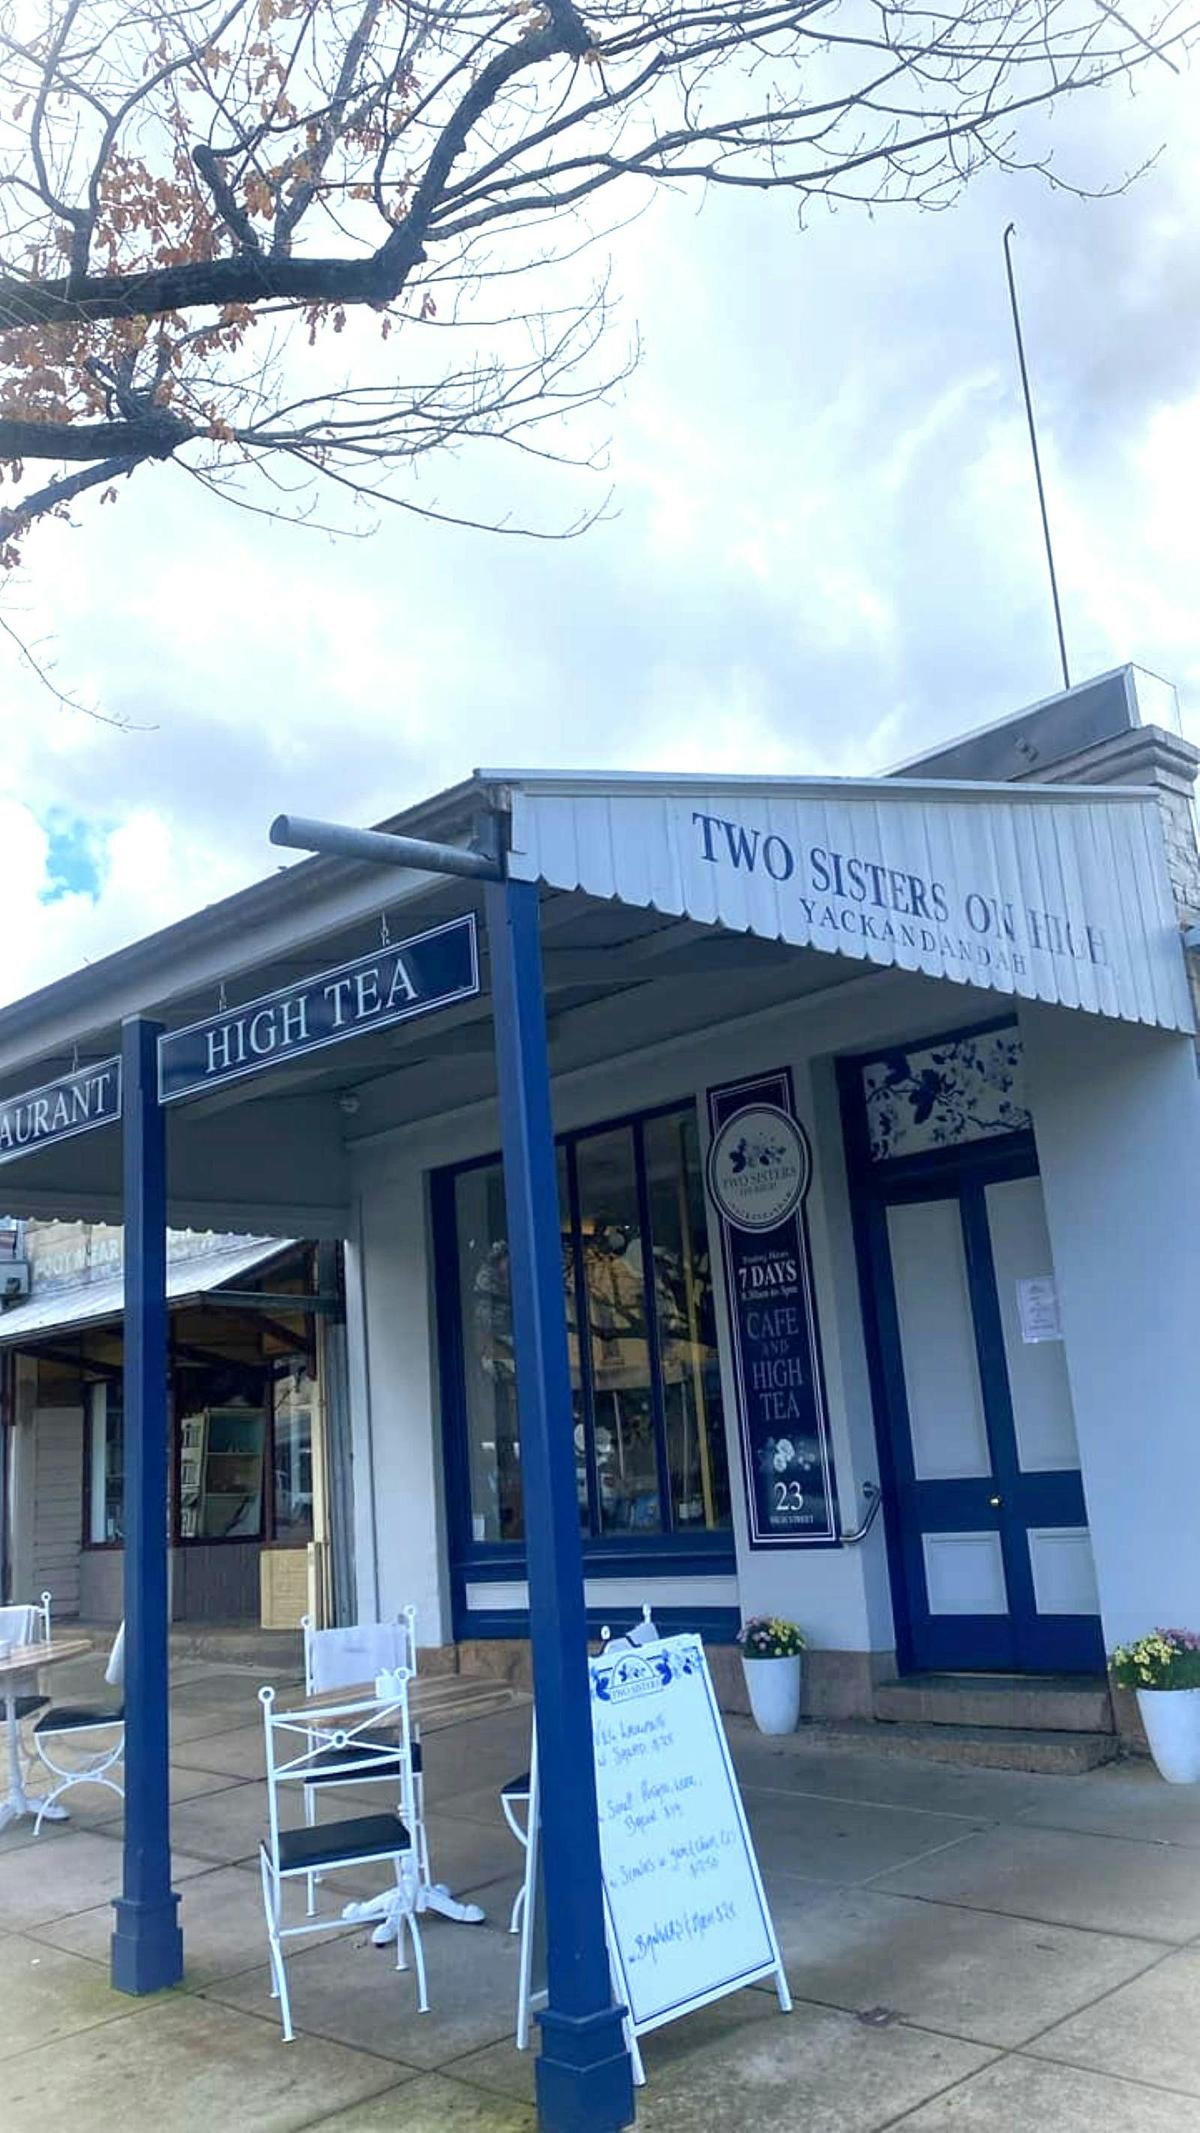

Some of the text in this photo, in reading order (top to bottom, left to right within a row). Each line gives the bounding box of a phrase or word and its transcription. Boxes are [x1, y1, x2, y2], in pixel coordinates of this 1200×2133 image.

[692, 812, 795, 882] TWO
[810, 846, 950, 923] SISTERS
[964, 893, 1018, 943] ON
[799, 897, 1028, 976] YACKANDANDAH
[205, 957, 419, 1074] HIGH TEA
[0, 1072, 111, 1150] AURANT
[739, 1259, 797, 1291] 7 DAYS
[752, 1357, 804, 1391] HIGH
[759, 1390, 801, 1422] TEA
[774, 1481, 804, 1510] 23
